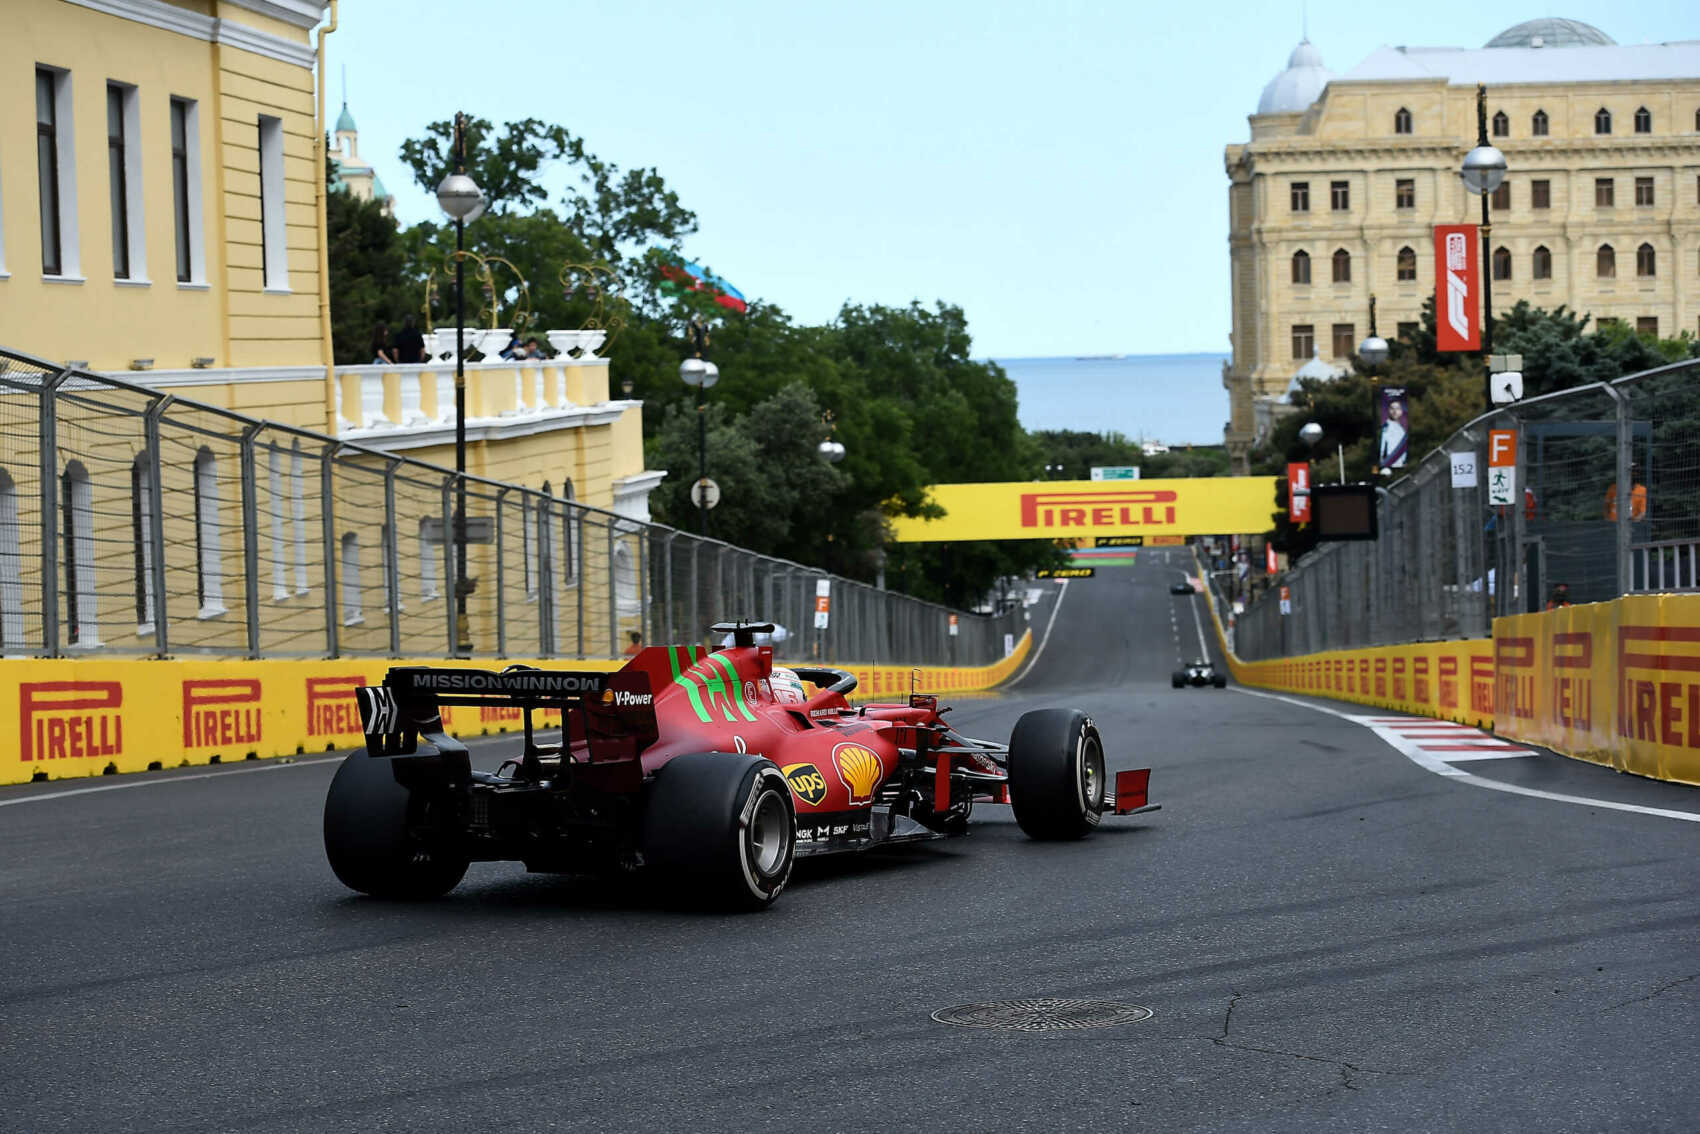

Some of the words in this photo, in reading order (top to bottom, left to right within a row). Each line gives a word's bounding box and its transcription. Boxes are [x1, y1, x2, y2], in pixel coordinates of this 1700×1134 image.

[1492, 434, 1512, 462] F
[1453, 463, 1474, 475] 152
[1020, 490, 1178, 528] PIRELLI
[413, 674, 503, 689] MISSION
[503, 676, 600, 691] WINNOW
[20, 681, 122, 761] PIRELLI
[182, 679, 262, 748] PIRELLI
[789, 772, 825, 799] ups
[832, 824, 849, 836] SKF
